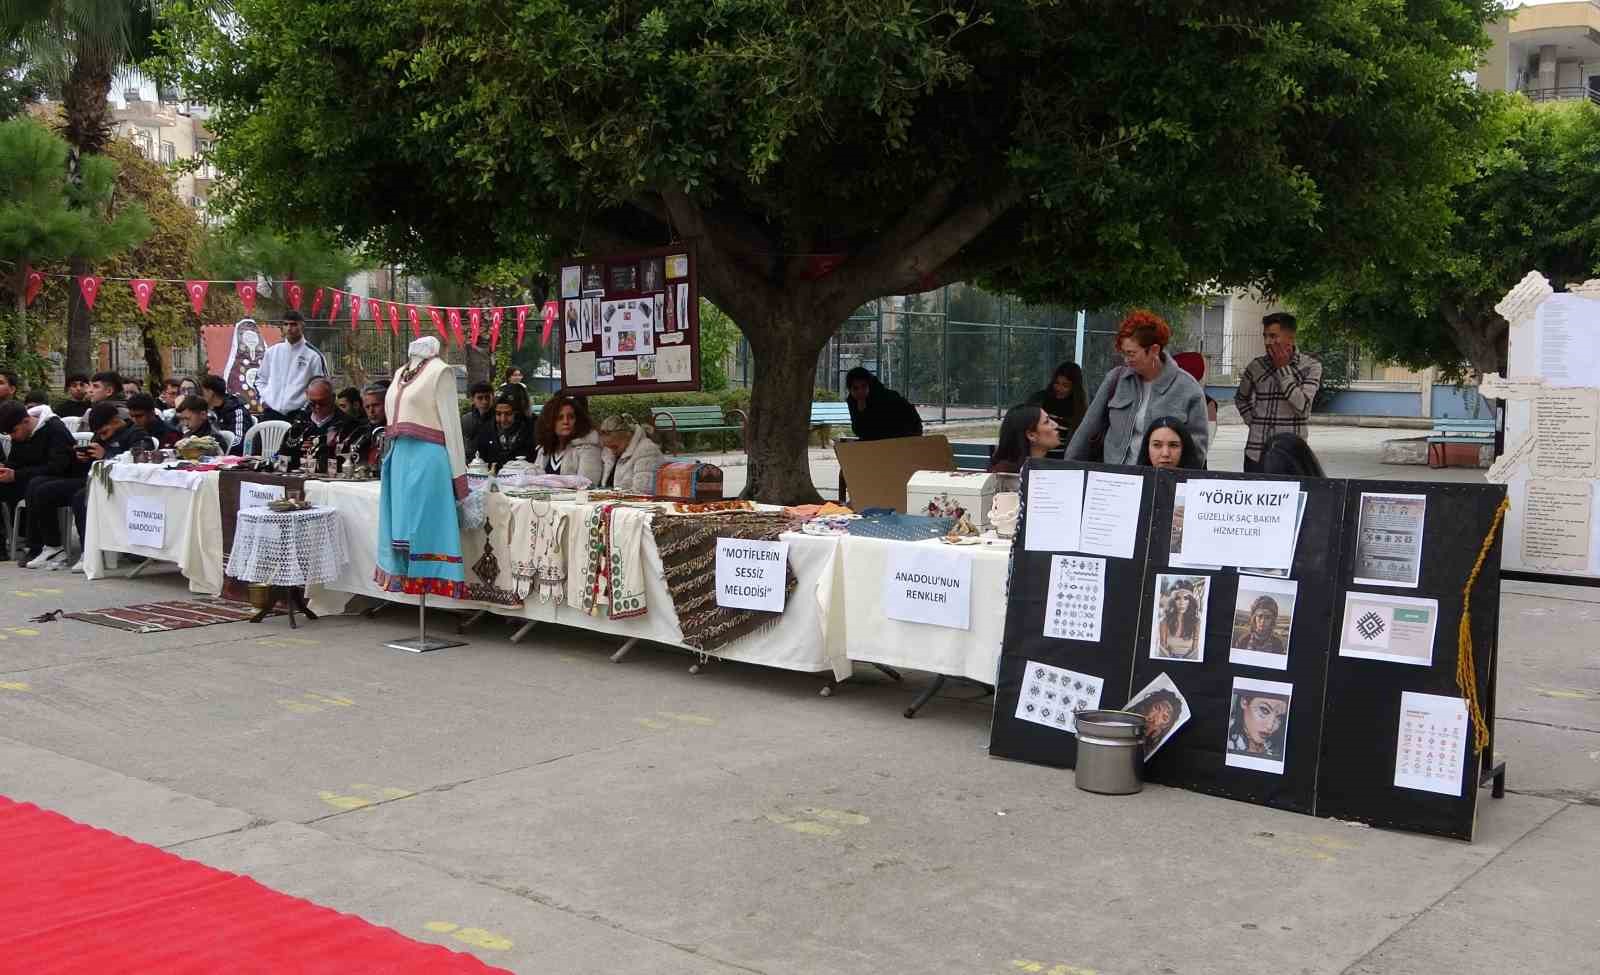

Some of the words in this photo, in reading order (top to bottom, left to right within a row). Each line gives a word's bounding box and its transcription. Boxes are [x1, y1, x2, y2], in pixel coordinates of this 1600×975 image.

[1199, 488, 1253, 506] "YÖRÜK
[1256, 492, 1290, 507] KIZI"
[1253, 514, 1281, 525] BAKIM
[735, 566, 765, 579] SESSİZ
[895, 571, 960, 588] ANADOLU'NUN
